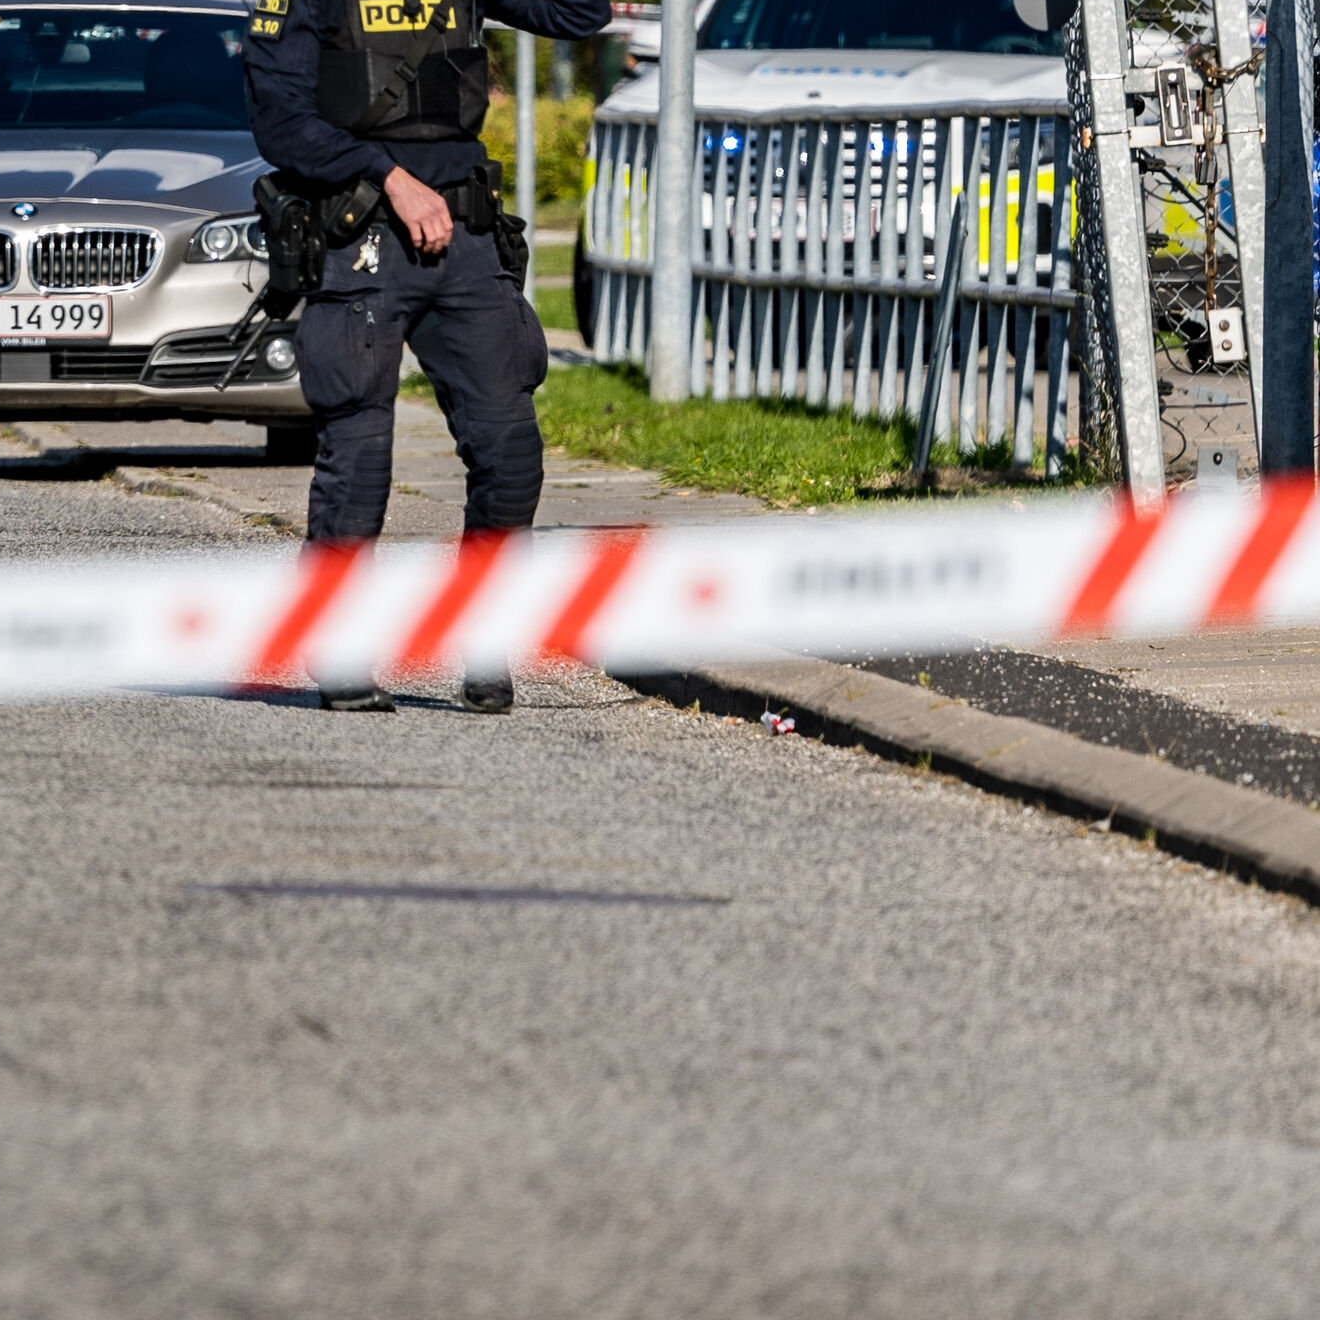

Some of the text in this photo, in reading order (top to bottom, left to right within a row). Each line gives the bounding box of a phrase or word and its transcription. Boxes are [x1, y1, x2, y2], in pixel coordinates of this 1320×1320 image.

[251, 18, 279, 34] 3.10
[11, 304, 41, 330] 14
[51, 304, 103, 330] 999
